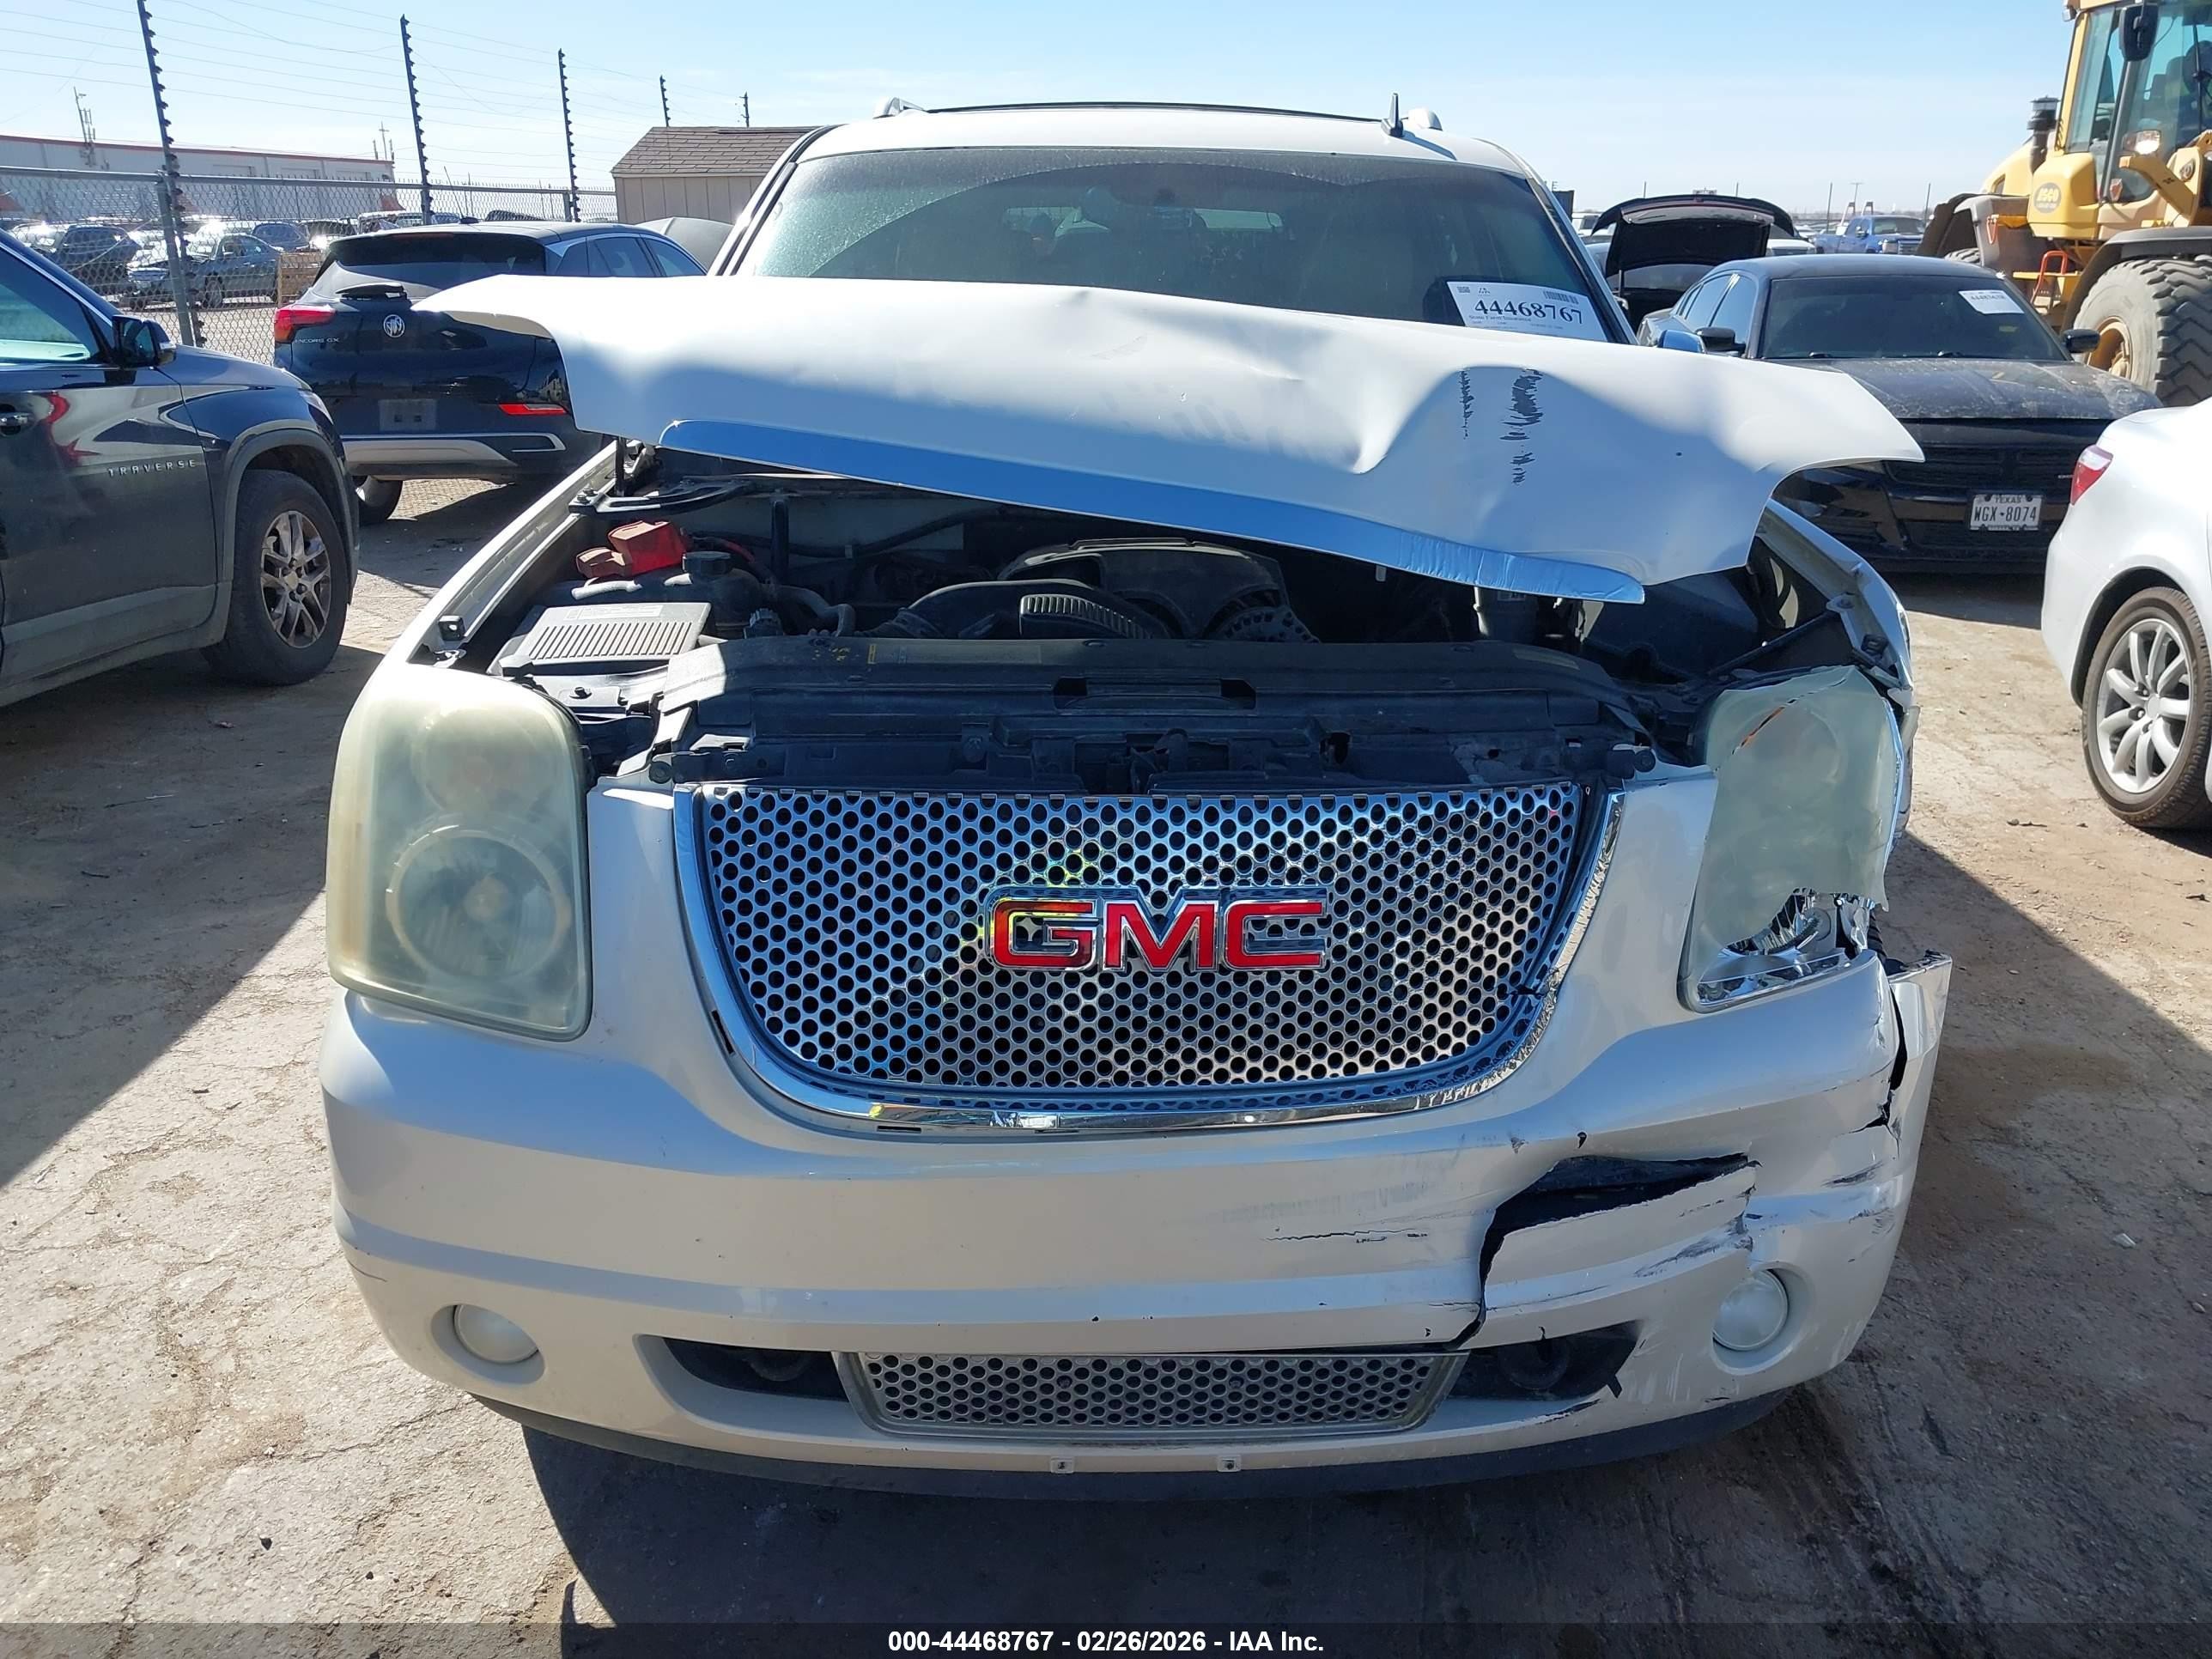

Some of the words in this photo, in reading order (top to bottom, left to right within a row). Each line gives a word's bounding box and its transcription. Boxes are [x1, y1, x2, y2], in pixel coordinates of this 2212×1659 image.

[1474, 299, 1583, 324] 44468767
[107, 459, 197, 477] TRAVERSE
[987, 889, 1328, 971] GMC
